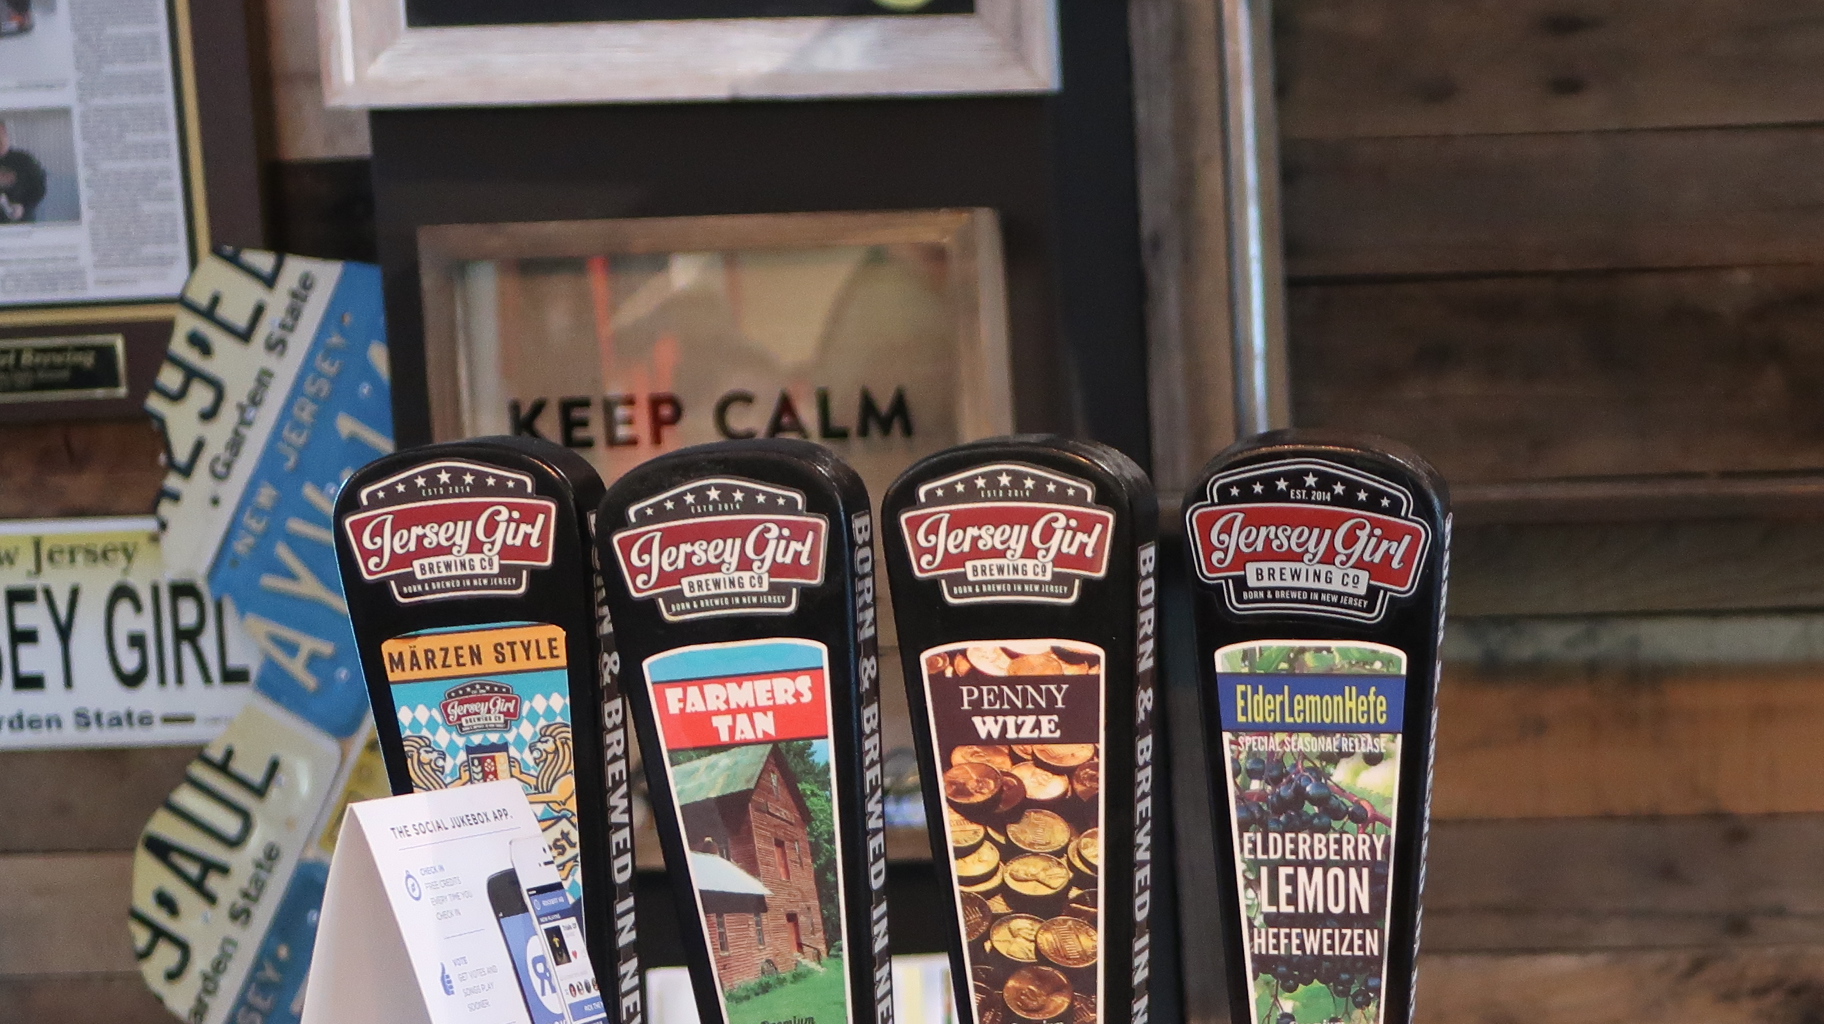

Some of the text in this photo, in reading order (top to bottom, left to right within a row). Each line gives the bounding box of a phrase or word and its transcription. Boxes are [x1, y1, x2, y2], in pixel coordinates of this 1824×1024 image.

[209, 271, 317, 481] Garden State
[278, 331, 347, 472] JERSEY
[508, 385, 915, 448] KEEP CALM
[1290, 489, 1331, 501] EST. 2014
[28, 535, 138, 578] Jersey
[362, 505, 545, 572] Jersey Girl
[630, 531, 742, 589] Jersey
[745, 522, 814, 573] Girl
[916, 512, 1103, 570] Jersey Girl
[1209, 512, 1412, 569] Jersey Girl
[419, 558, 475, 576] BREWING
[688, 576, 745, 593] BREWING
[852, 511, 876, 642] BORN
[972, 563, 1028, 577] BREWING
[1255, 567, 1333, 584] BREWING
[1138, 543, 1156, 674] BORN
[1243, 591, 1264, 600] BORN
[1275, 590, 1308, 599] BREWED
[1310, 592, 1318, 600] IN
[1321, 592, 1338, 603] NEW
[1340, 595, 1369, 608] JERSEY
[105, 578, 251, 690] GIRL
[388, 637, 560, 673] MÄRZEN STYLE
[602, 652, 620, 687] &
[861, 654, 878, 690] &
[447, 700, 488, 721] Jersey
[664, 675, 813, 714] FARMERS
[959, 684, 1069, 710] PENNY
[1137, 687, 1154, 724] &
[1236, 685, 1388, 725] ElderLemonHefe
[74, 706, 154, 728] State
[712, 711, 776, 742] TAN
[971, 715, 1061, 739] WIZE
[1238, 736, 1386, 753] SPECIAL SEASONAL RELEASE
[603, 697, 632, 887] BREWED
[861, 701, 886, 890] BREWED
[391, 808, 513, 839] THE SOCIAL JUKEBOX APP.
[1134, 734, 1152, 922] BREWED
[1243, 832, 1386, 861] ELDERBERRY
[229, 841, 281, 927] State
[1260, 866, 1370, 914] LEMON
[613, 893, 637, 948] IN
[871, 896, 889, 952] IN
[1132, 929, 1150, 985] IN
[1253, 928, 1379, 956] HEFEWEIZEN
